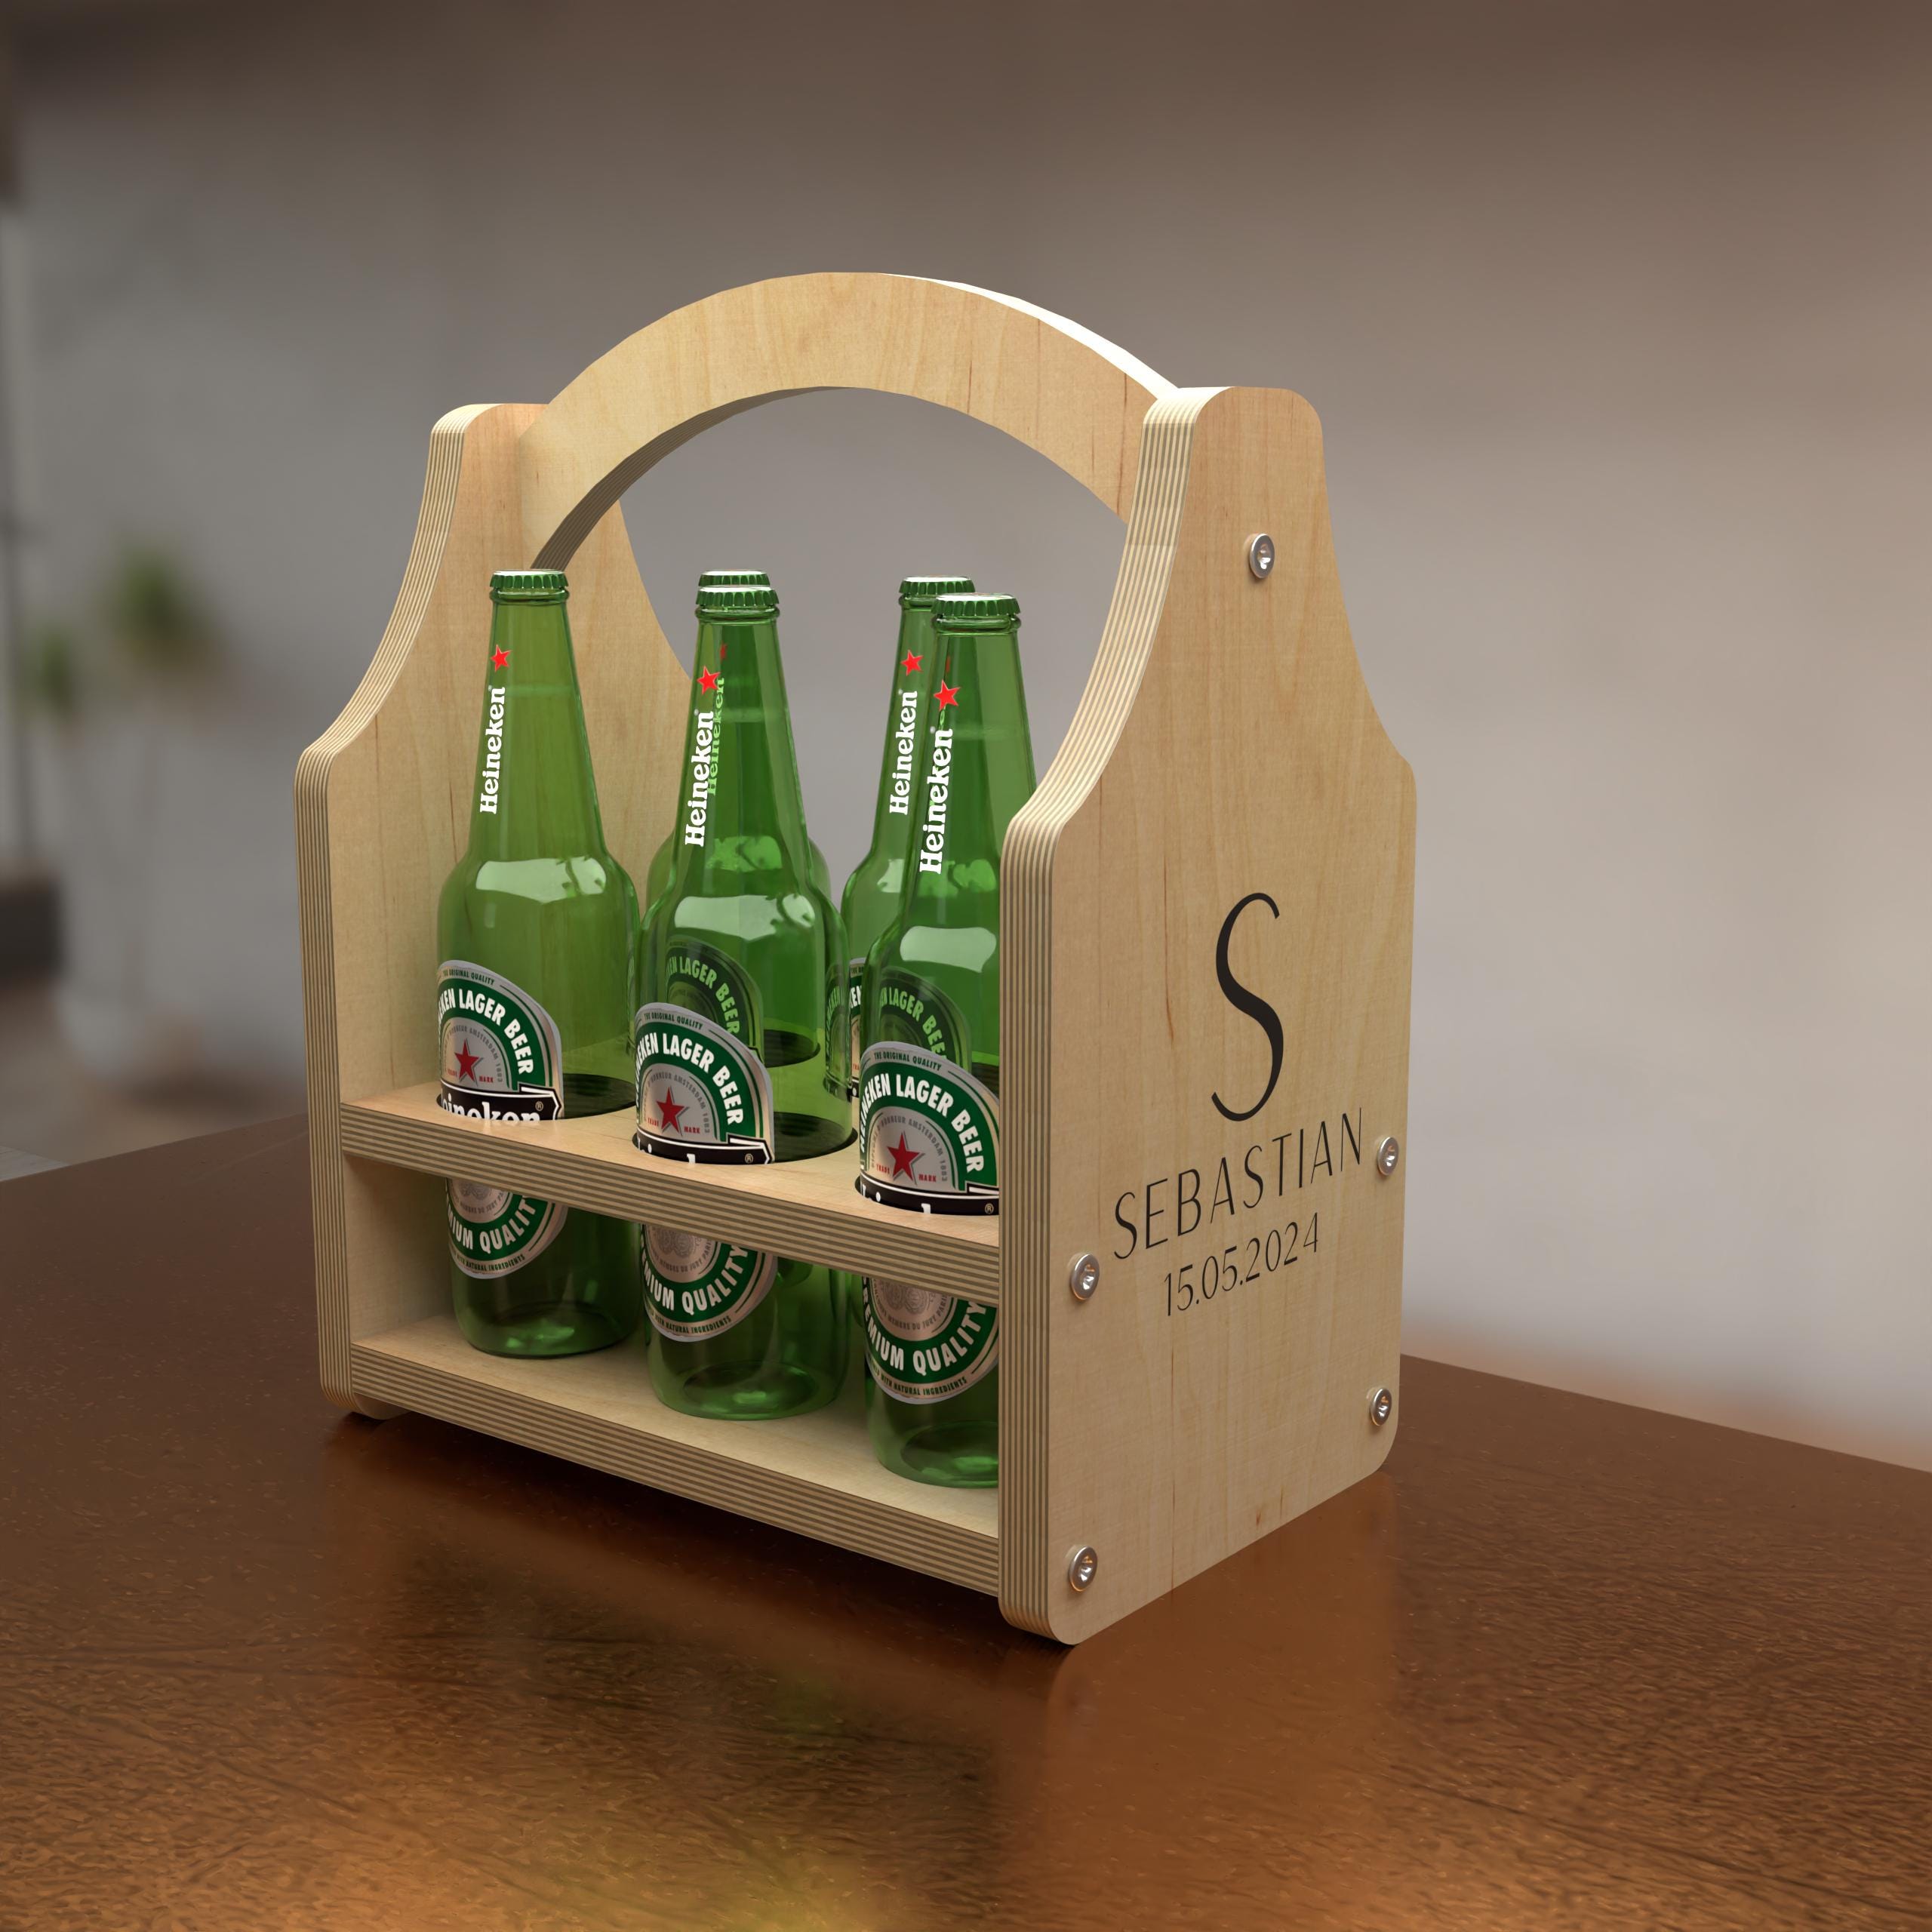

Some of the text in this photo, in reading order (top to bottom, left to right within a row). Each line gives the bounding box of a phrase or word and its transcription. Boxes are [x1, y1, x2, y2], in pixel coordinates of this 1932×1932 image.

[479, 687, 506, 814] Heineken
[685, 711, 714, 848] Heineken
[889, 691, 918, 816] Heineken
[919, 728, 954, 875] Heineken
[471, 972, 495, 986] QUALITY
[679, 956, 718, 989] LAGER
[1211, 892, 1284, 1122] S
[459, 988, 506, 1026] LAGER
[504, 1019, 534, 1075] BEER
[651, 1012, 675, 1022] ORIGINAL
[677, 1016, 703, 1030] QUALITY
[883, 1051, 910, 1062] ORIGINAL
[912, 1056, 942, 1071] QUALITY
[889, 986, 946, 1058] LAGER BEE
[663, 1032, 715, 1074] LAGER
[712, 1065, 743, 1125] BEER
[896, 1074, 955, 1117] LAGER
[951, 1108, 985, 1174] BEER
[918, 1174, 937, 1183] MARK
[1113, 1107, 1362, 1260] SEBASTIAN
[479, 1197, 536, 1254] QUALIT
[1163, 1212, 1319, 1317] 15.05.2024
[681, 1245, 749, 1315] QUALITY
[912, 1301, 987, 1376] QUALITY
[893, 1382, 920, 1395] NATURAL
[923, 1377, 967, 1395] INGREDIENTS
